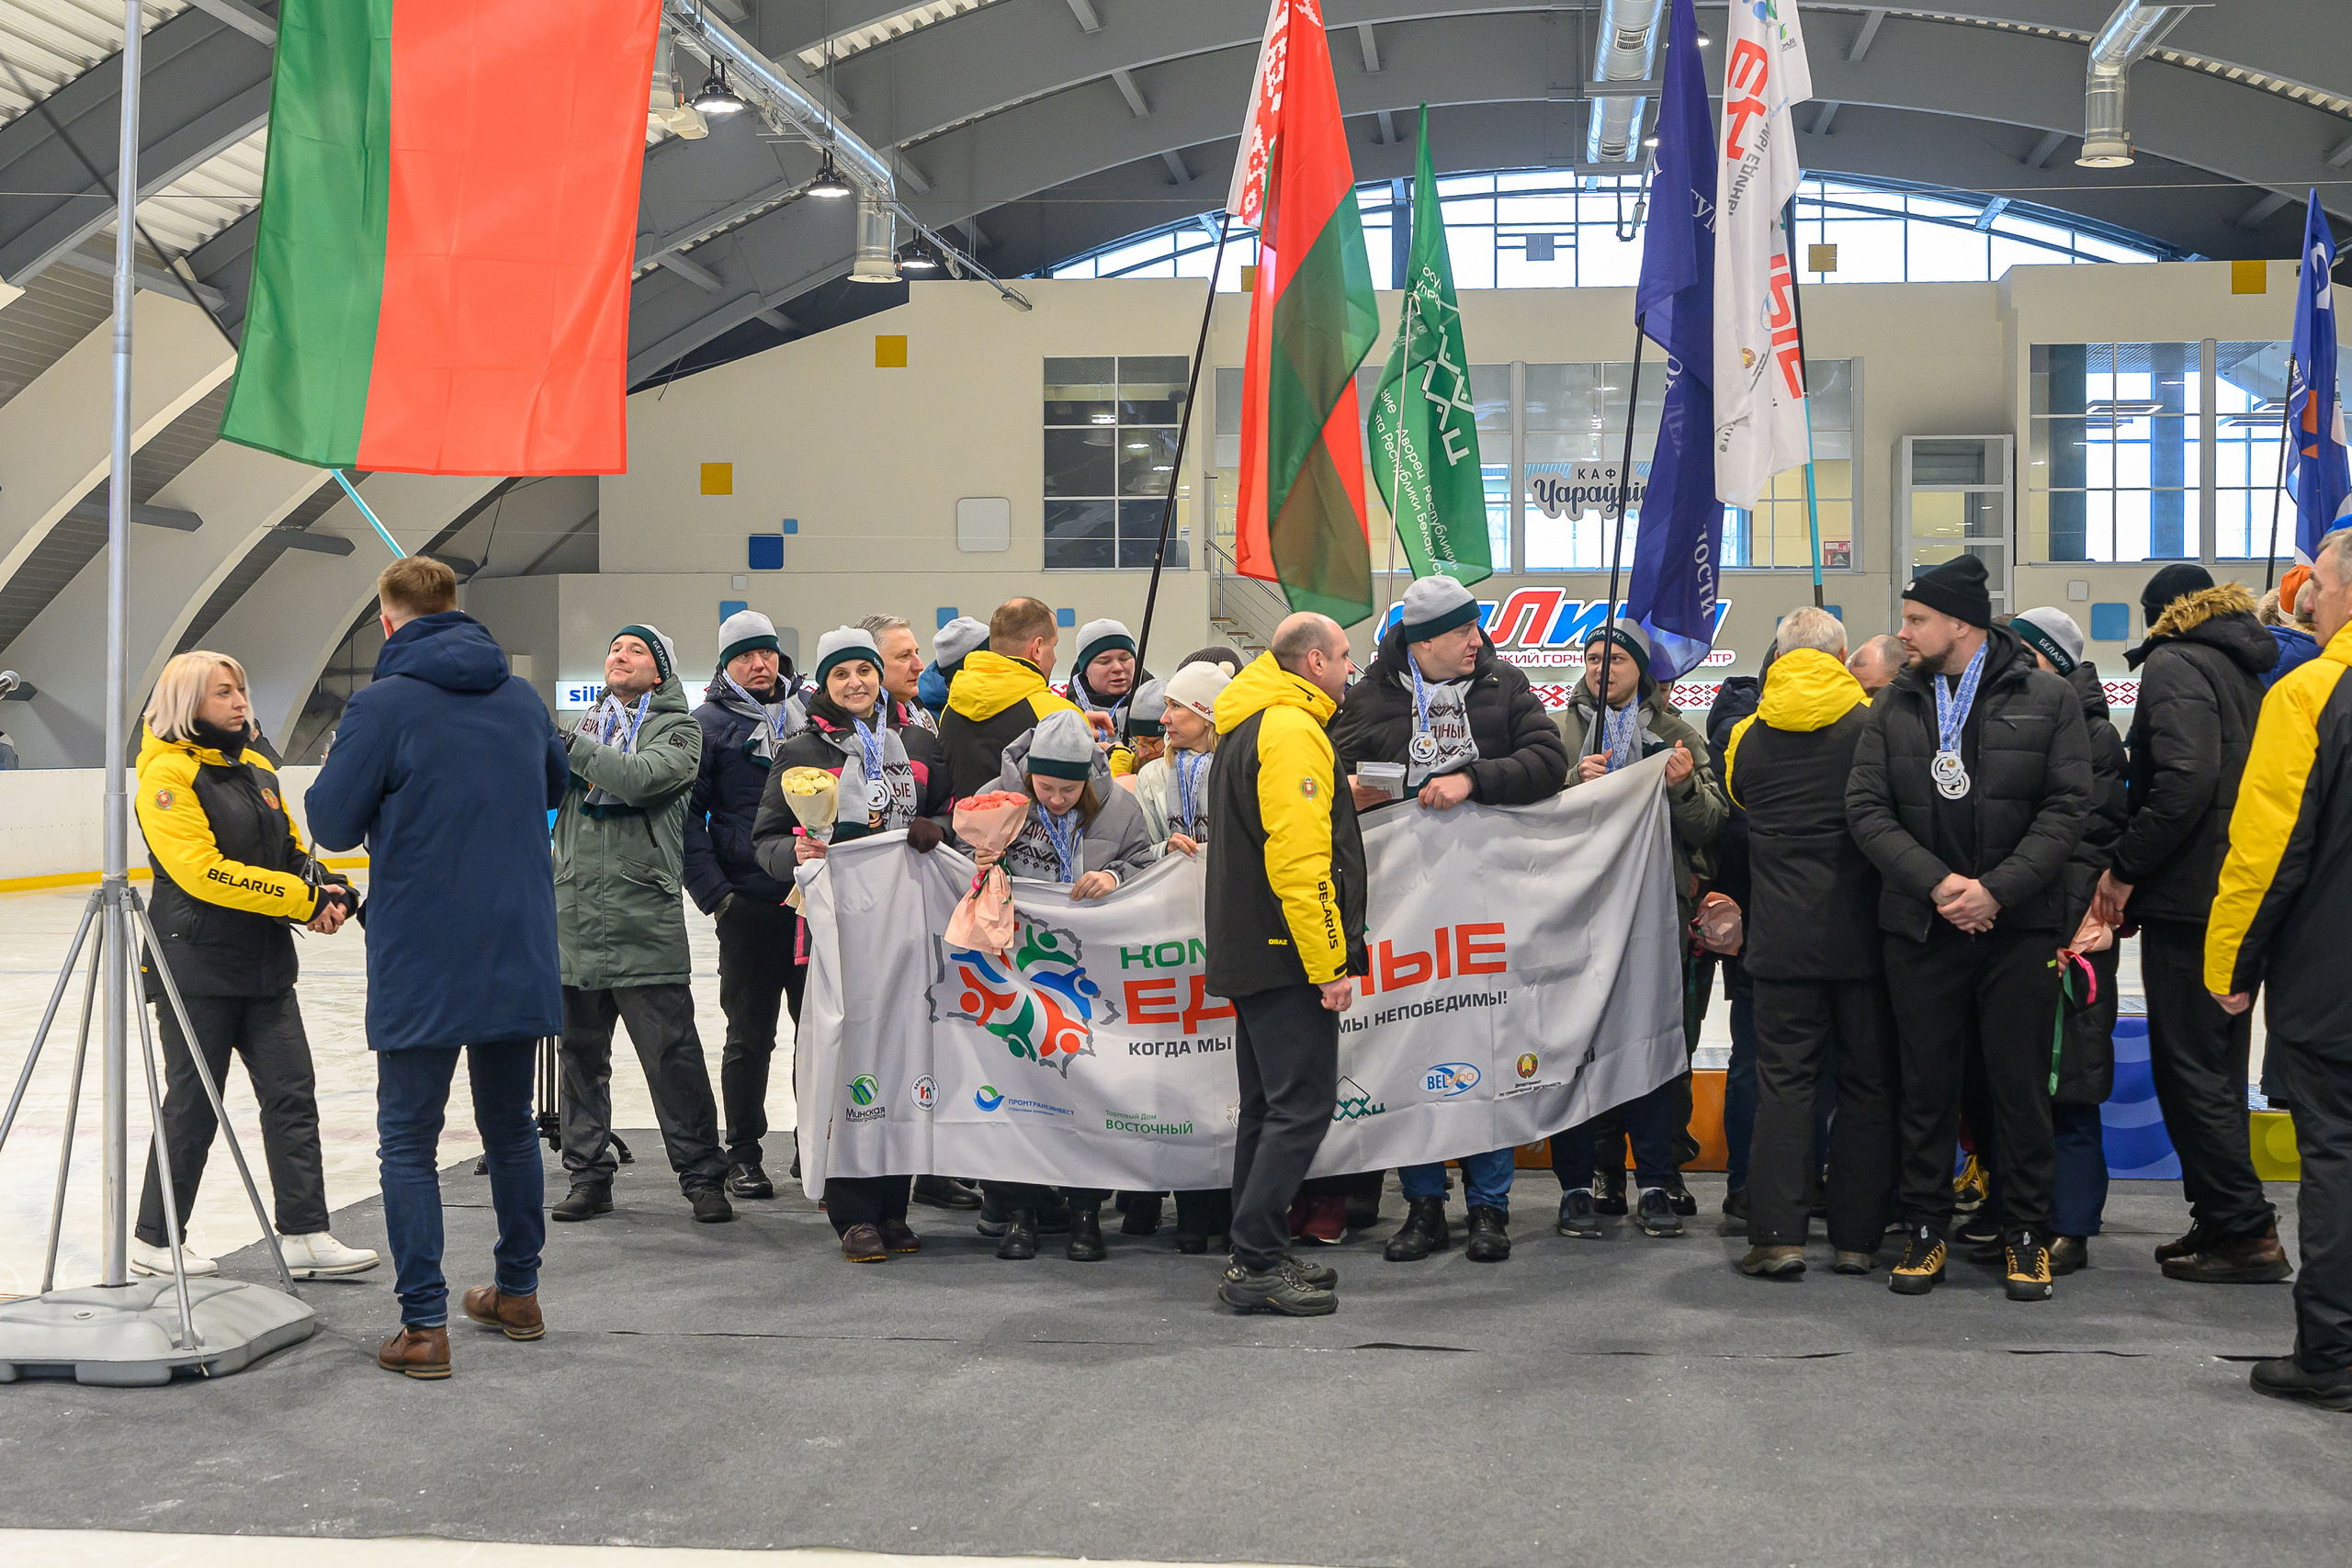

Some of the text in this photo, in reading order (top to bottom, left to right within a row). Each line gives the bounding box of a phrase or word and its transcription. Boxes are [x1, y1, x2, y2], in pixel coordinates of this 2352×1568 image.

[1577, 468, 1617, 479] КАФ
[1422, 484, 1459, 570] Республики»
[1497, 651, 1733, 664] СКИЙ ГОРН НТР
[207, 867, 286, 898] BELARUS
[1317, 880, 1339, 950] BELARUS
[1120, 938, 1206, 970] КОМ
[1128, 990, 1508, 1058] КОГДА МЫ МЫ НЕПОБЕДИМЫ!
[845, 1106, 886, 1119] Минская
[1008, 1099, 1075, 1116] ПРОМТРАНСИНВЕСТ
[1105, 1119, 1193, 1135] ВОСТОЧНЫЙ
